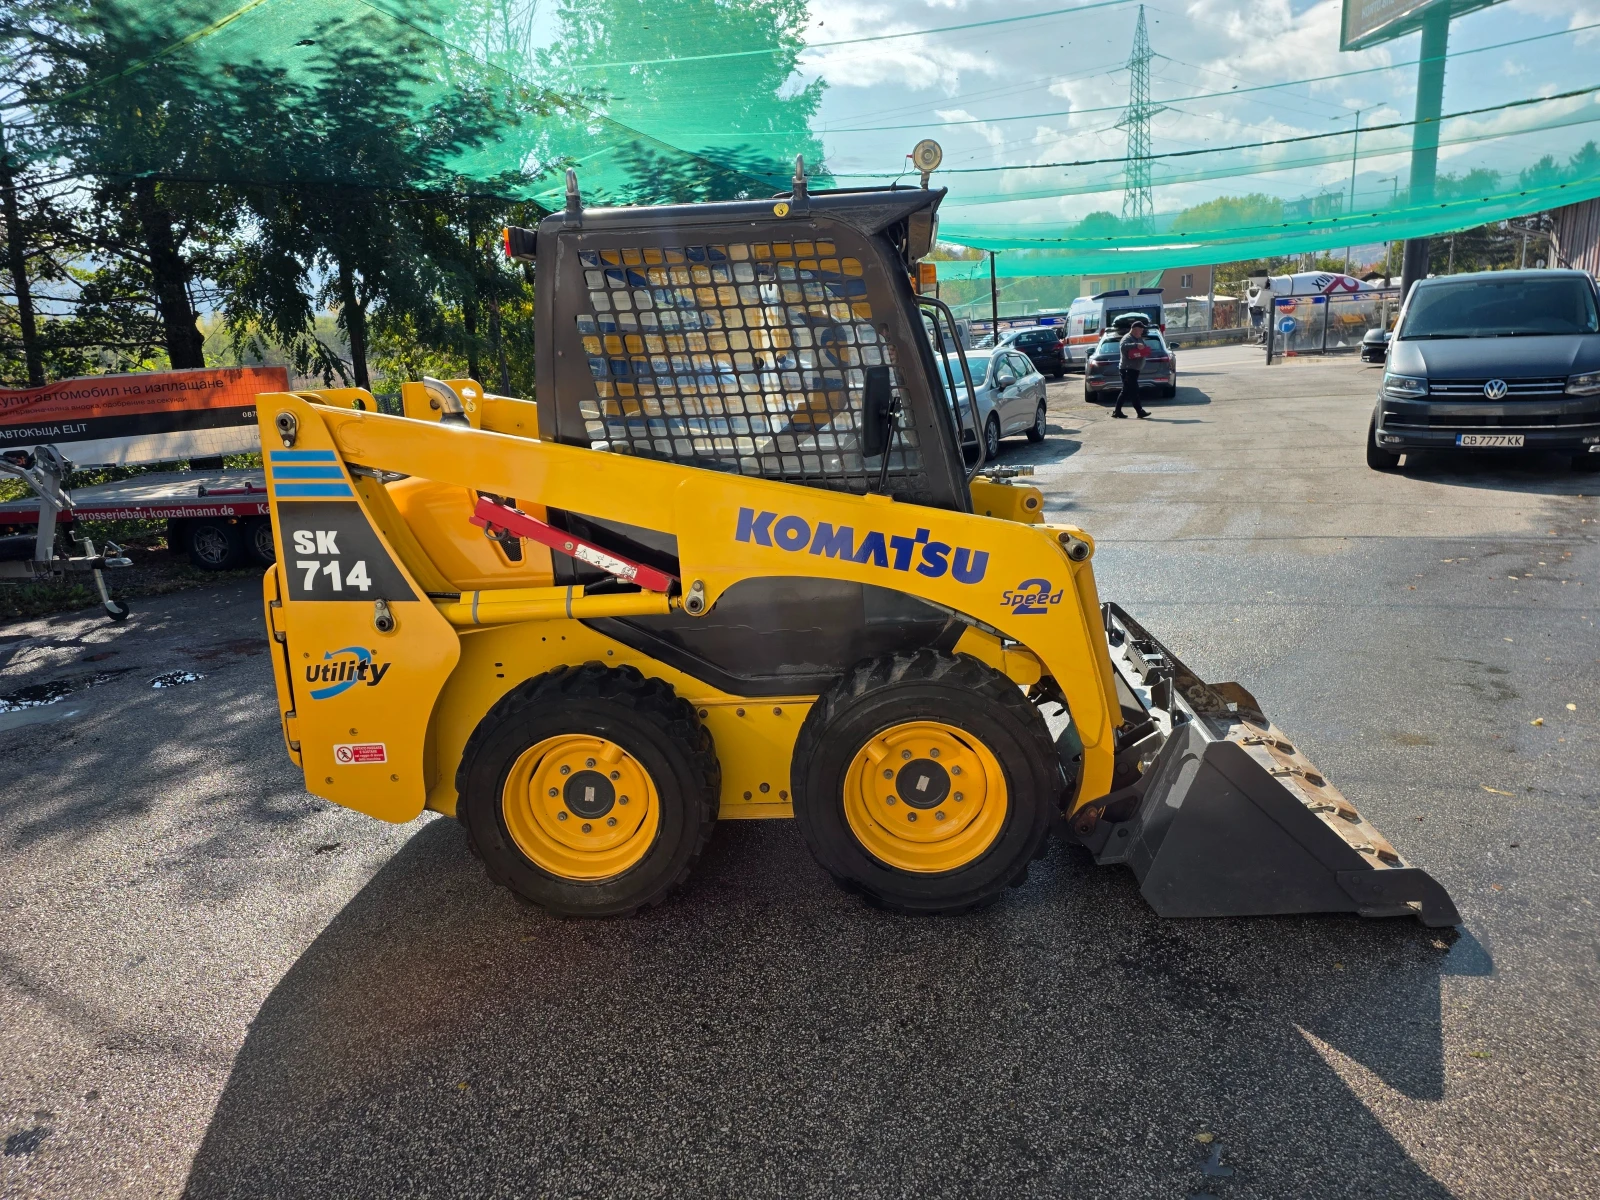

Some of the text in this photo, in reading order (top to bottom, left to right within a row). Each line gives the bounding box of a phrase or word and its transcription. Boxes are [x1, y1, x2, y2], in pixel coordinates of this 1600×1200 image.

[0, 379, 224, 408] упи автомобил на изплащане
[0, 423, 87, 439] АВТОКЪЩА ELIT
[1463, 436, 1477, 445] CB
[1479, 436, 1506, 445] 7777
[1507, 436, 1522, 445] KK
[75, 504, 235, 521] arosseriebau-konzelmann.de
[293, 530, 341, 555] SK
[735, 507, 989, 584] KOMATSU
[296, 560, 372, 592] 714
[1000, 578, 1064, 615] Speed 2
[306, 660, 392, 687] Utility
